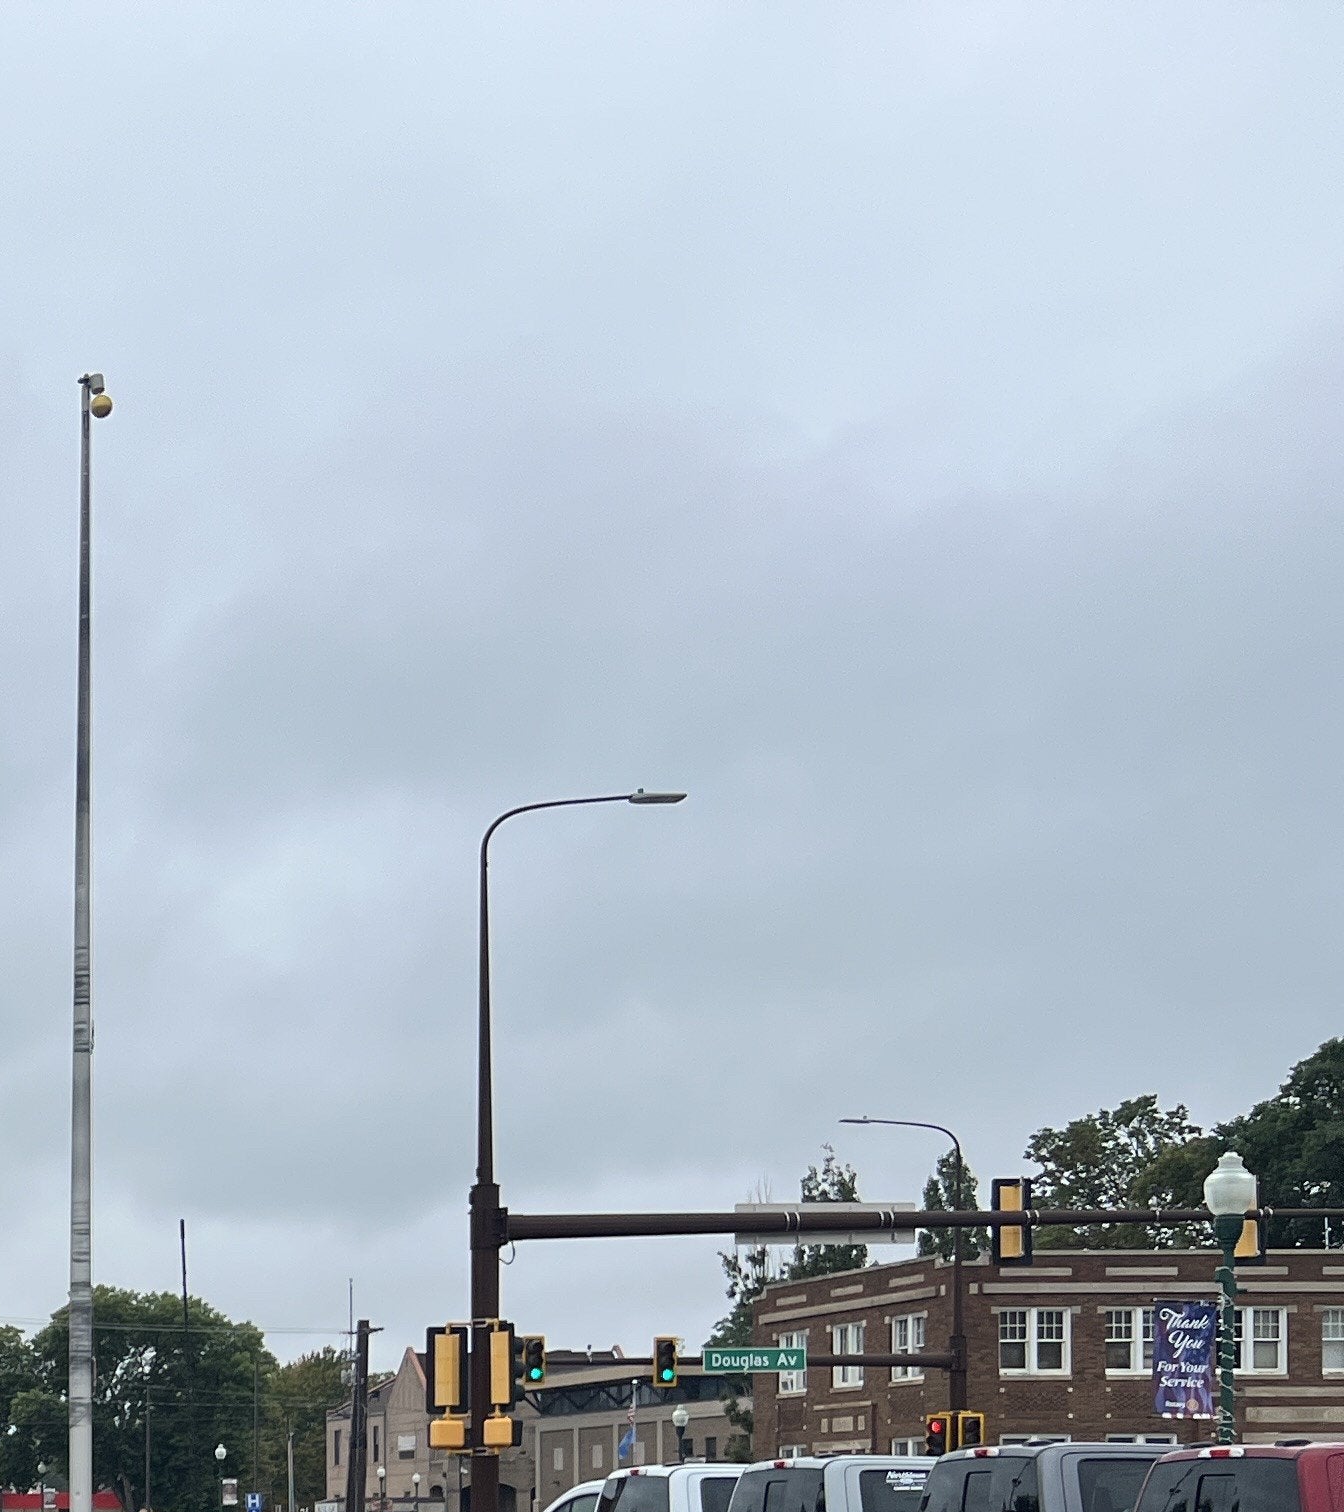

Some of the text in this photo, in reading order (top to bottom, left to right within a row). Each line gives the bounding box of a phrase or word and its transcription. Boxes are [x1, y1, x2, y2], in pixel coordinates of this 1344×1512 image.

[1159, 1307, 1210, 1330] Thank
[1168, 1330, 1206, 1359] You
[711, 1352, 797, 1371] Douglas Av
[1157, 1361, 1209, 1373] For Your
[1159, 1375, 1205, 1388] Service
